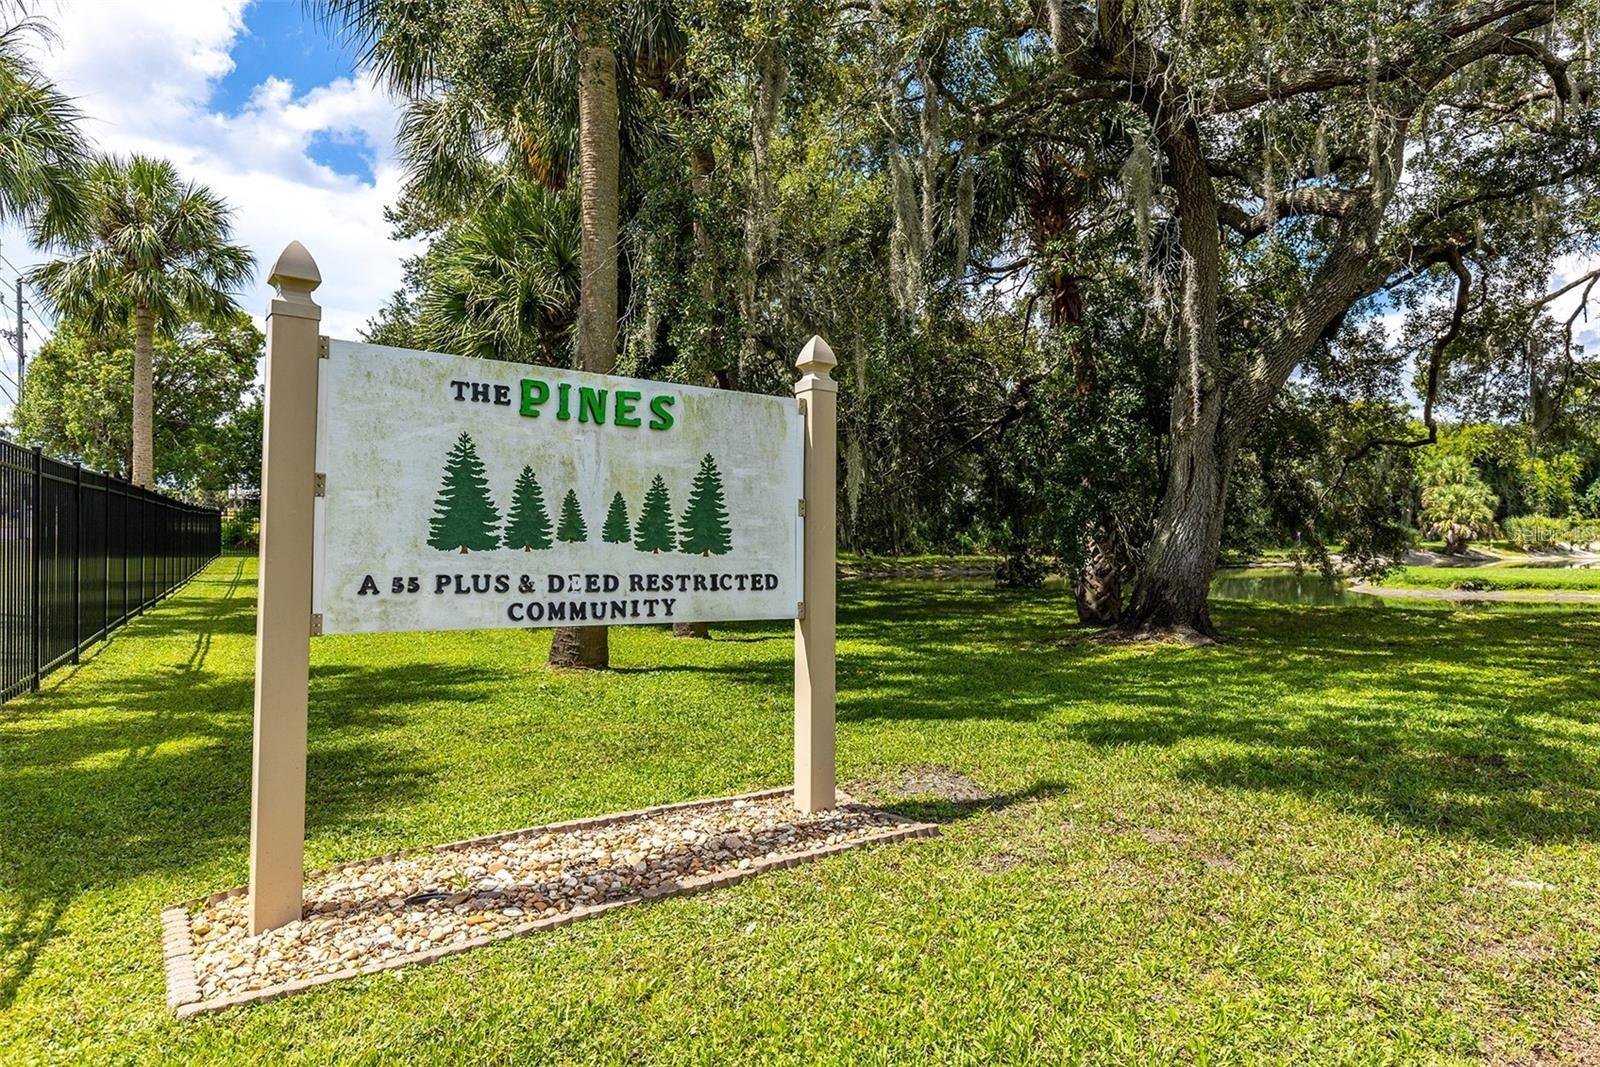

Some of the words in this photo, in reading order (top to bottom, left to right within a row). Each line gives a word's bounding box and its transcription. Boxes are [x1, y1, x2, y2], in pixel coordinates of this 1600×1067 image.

[450, 380, 511, 406] THE
[519, 378, 676, 431] PINES
[357, 575, 380, 595] A
[391, 576, 420, 593] 55
[434, 574, 510, 594] PLUS
[518, 574, 536, 593] &
[547, 574, 619, 593] DEED
[629, 573, 779, 591] RESTRICTED
[507, 598, 676, 621] COMMUNITY
